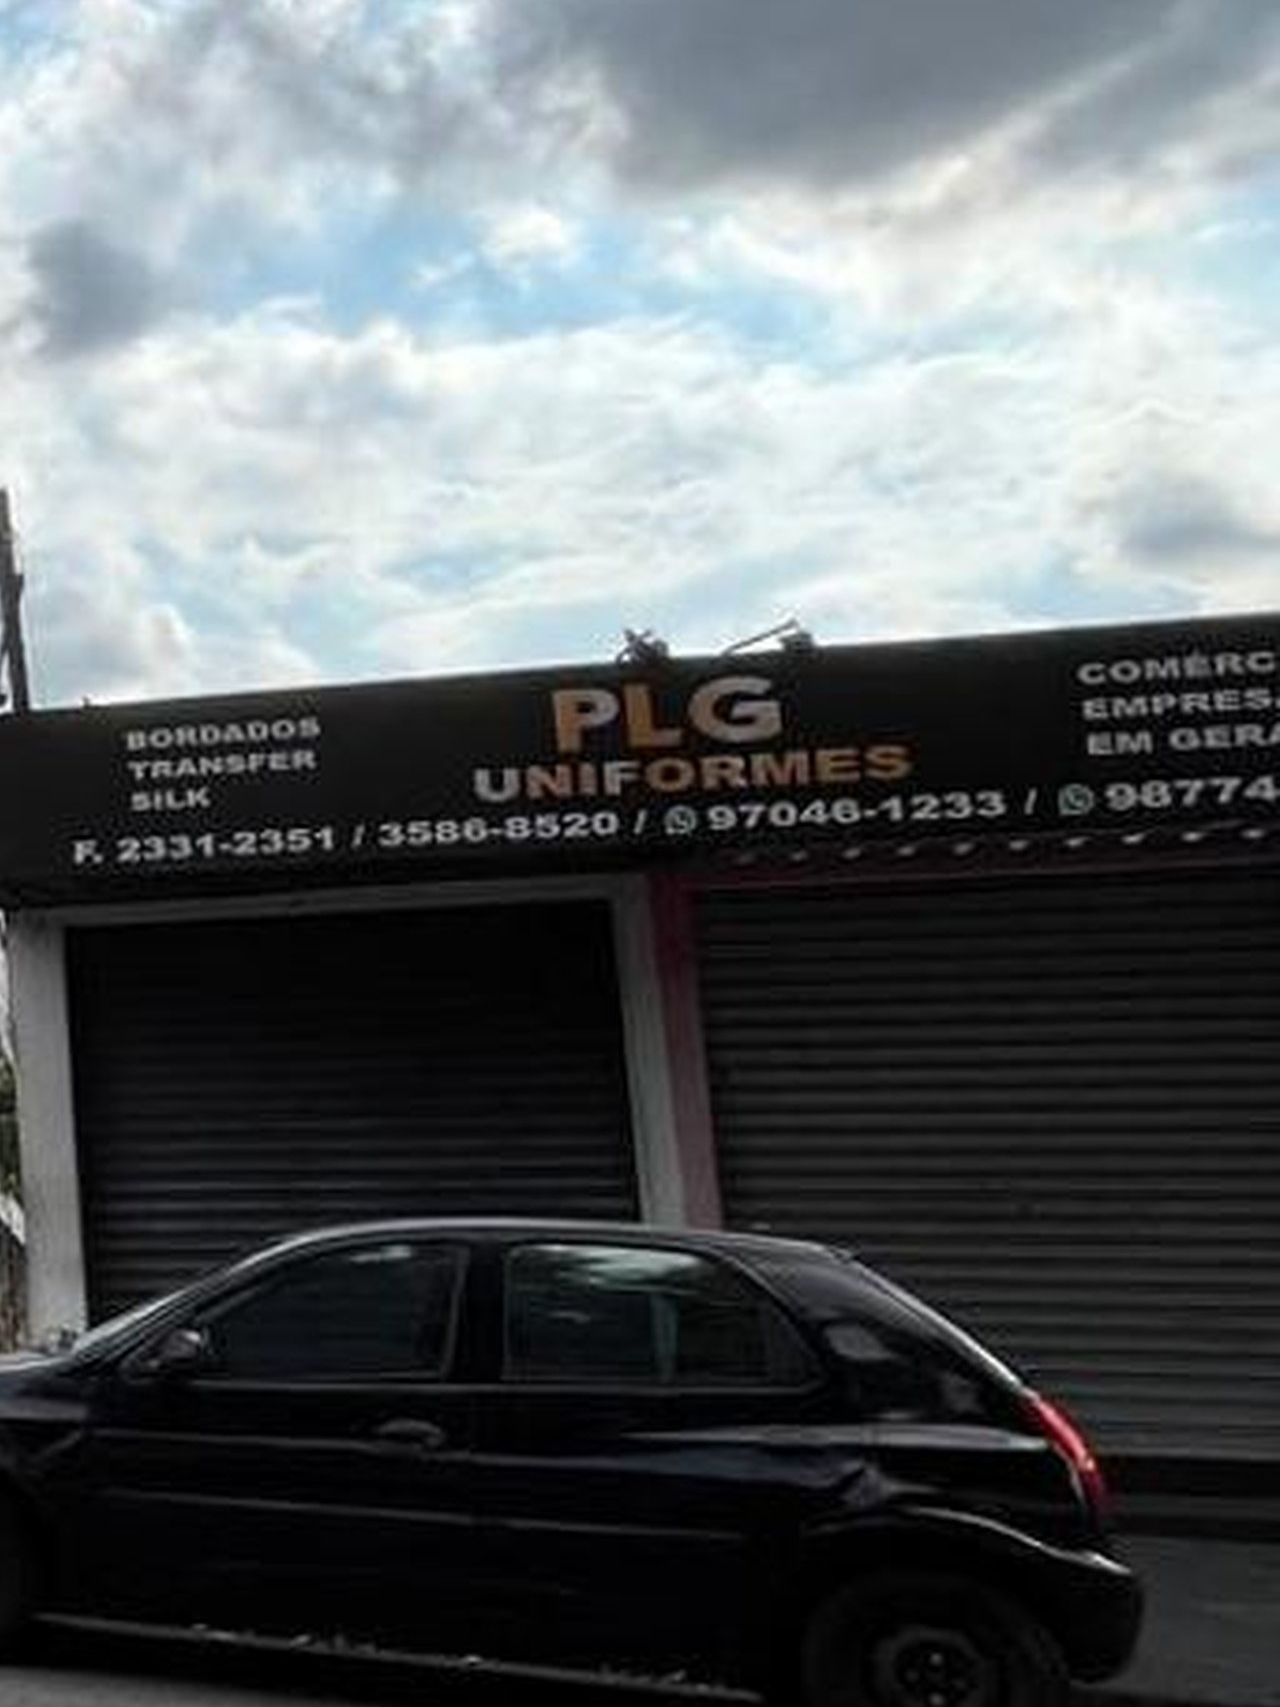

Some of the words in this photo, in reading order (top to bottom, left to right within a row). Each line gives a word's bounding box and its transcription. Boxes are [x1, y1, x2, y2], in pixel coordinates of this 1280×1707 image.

[550, 676, 784, 751] PLG
[1082, 688, 1280, 720] EMPRES
[126, 717, 320, 751] BORDADOS
[1087, 732, 1154, 756] EM
[127, 750, 317, 779] TRANSFER
[472, 744, 916, 802] UNIFORMES
[130, 788, 211, 812] SILK
[73, 840, 103, 864] F.
[116, 826, 334, 864] 2331-2351
